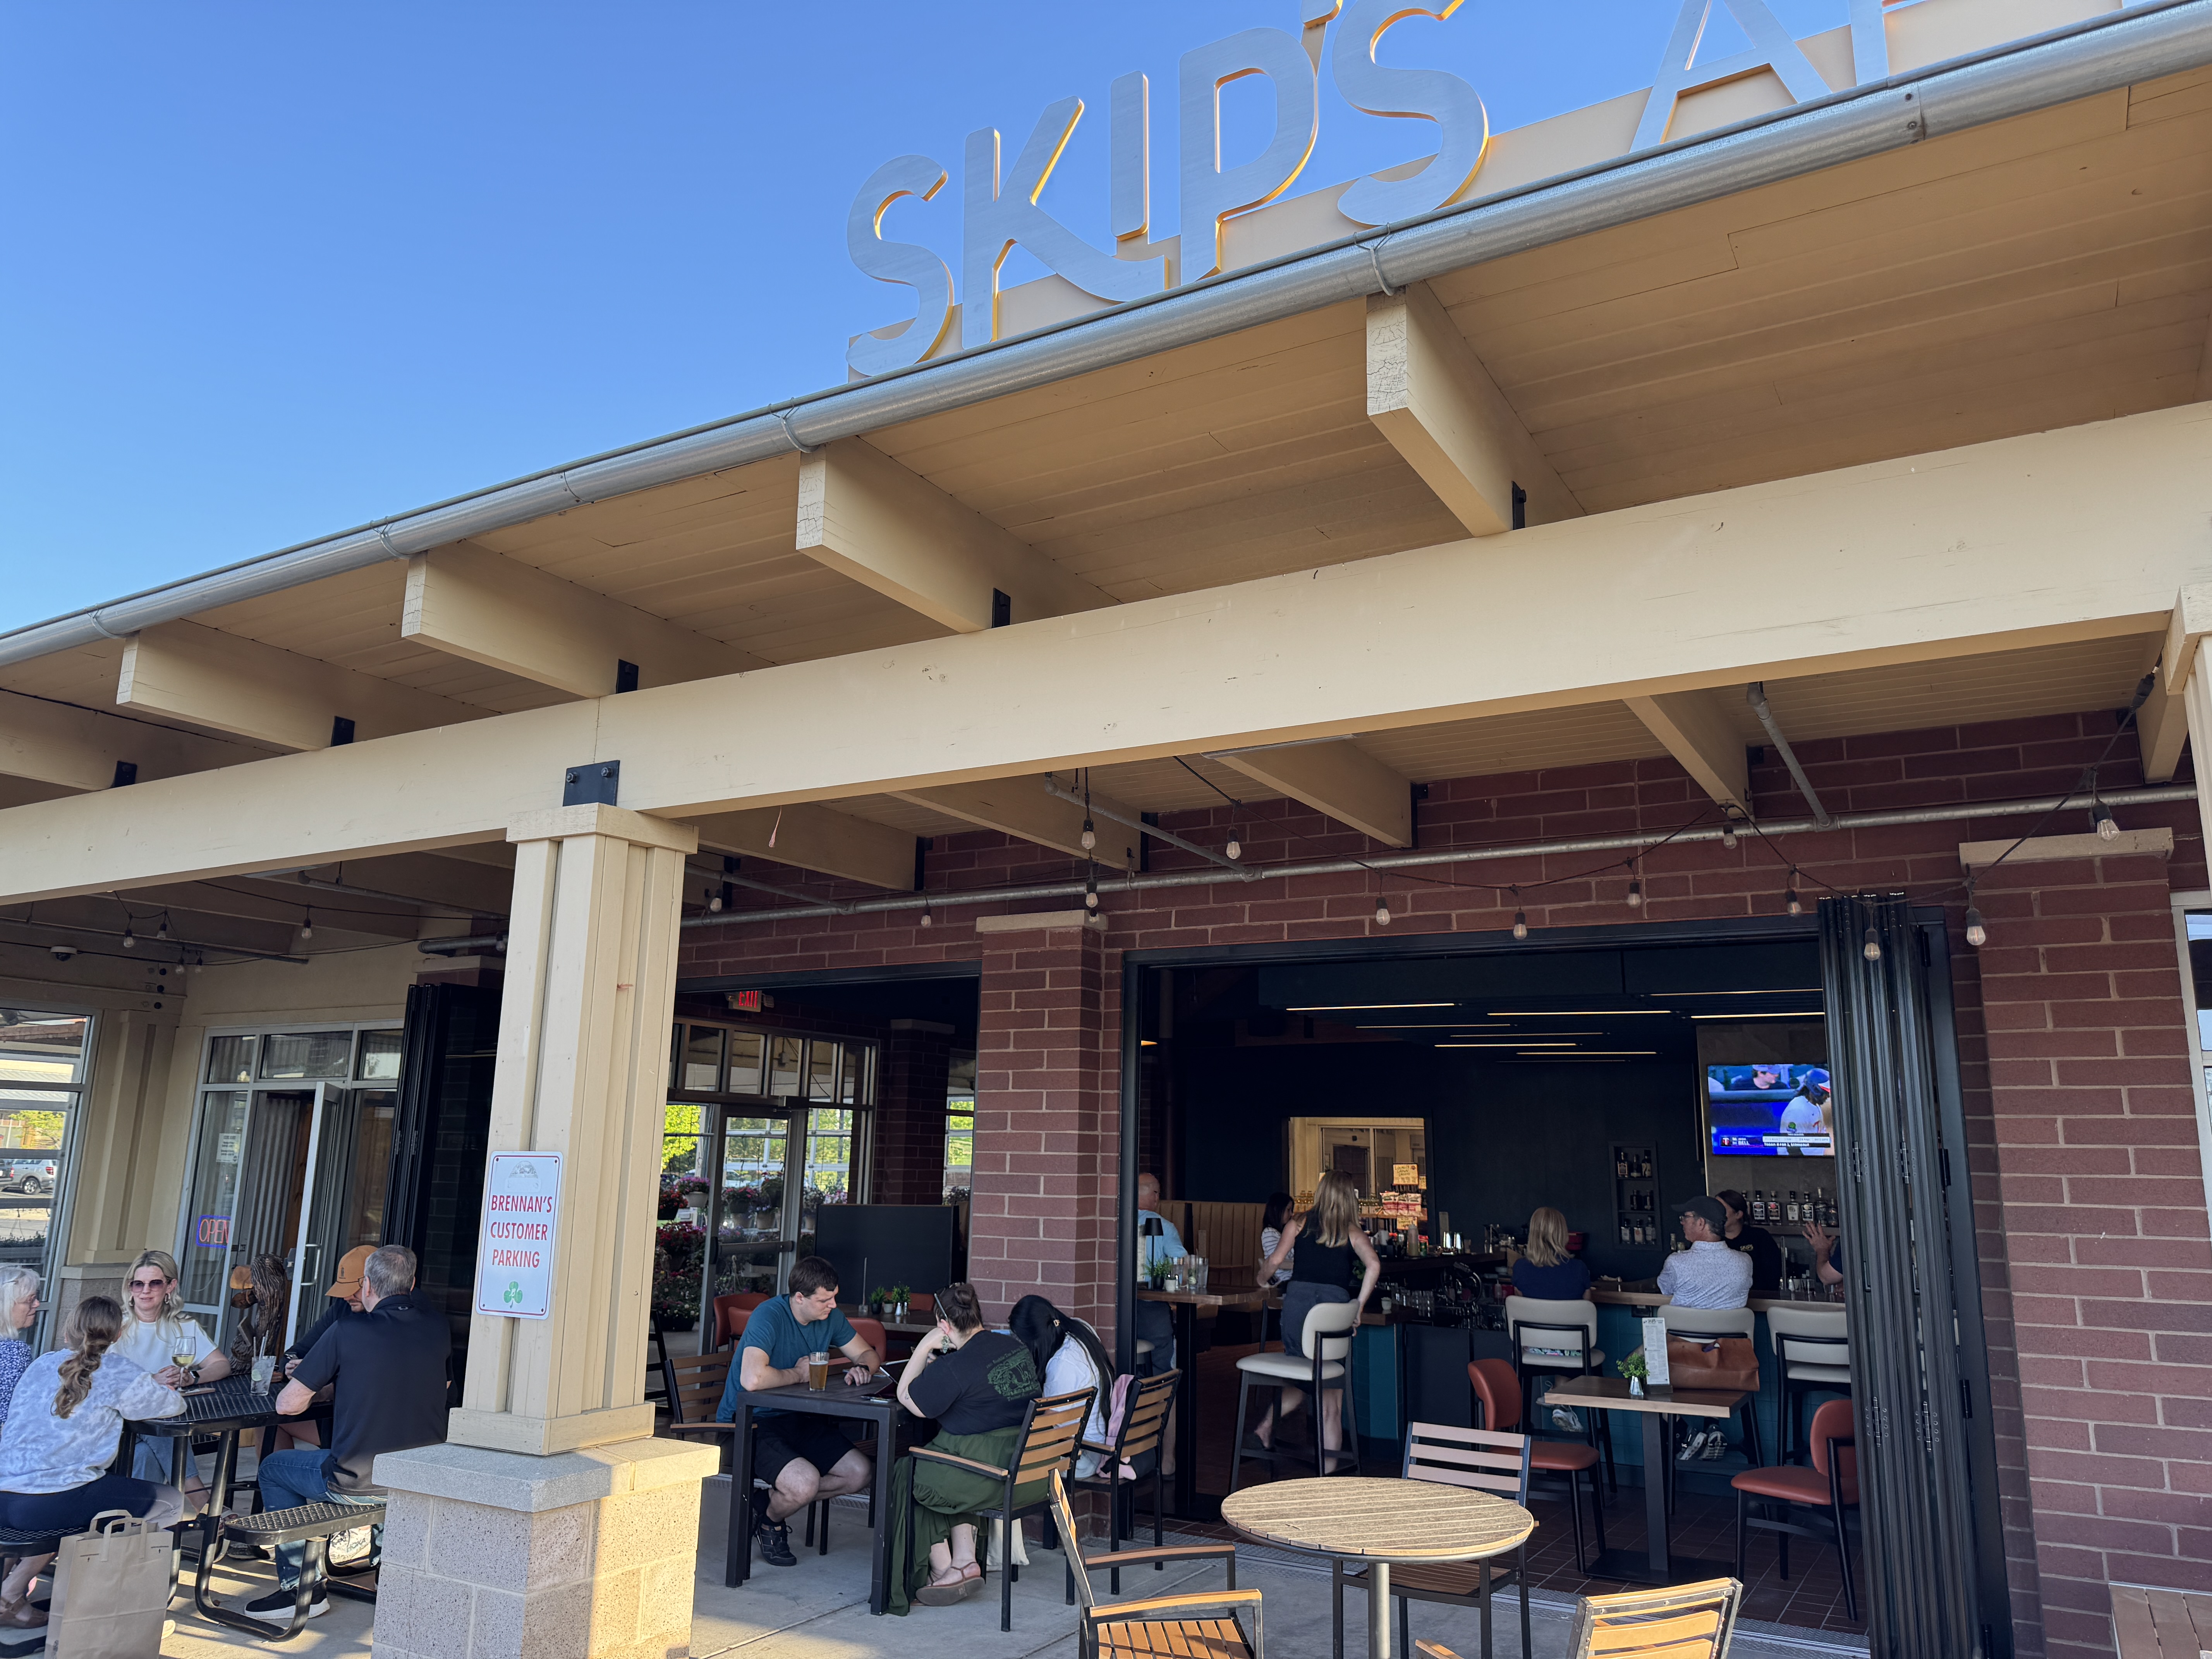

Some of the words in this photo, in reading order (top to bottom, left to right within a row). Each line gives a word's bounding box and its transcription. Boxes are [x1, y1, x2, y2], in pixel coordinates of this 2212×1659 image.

[846, 0, 1489, 376] SKIP'S
[491, 1195, 553, 1213] BRENNAN'S
[199, 1219, 230, 1244] OPEN
[490, 1221, 548, 1241] CUSTOMER
[492, 1249, 540, 1268] PARKING
